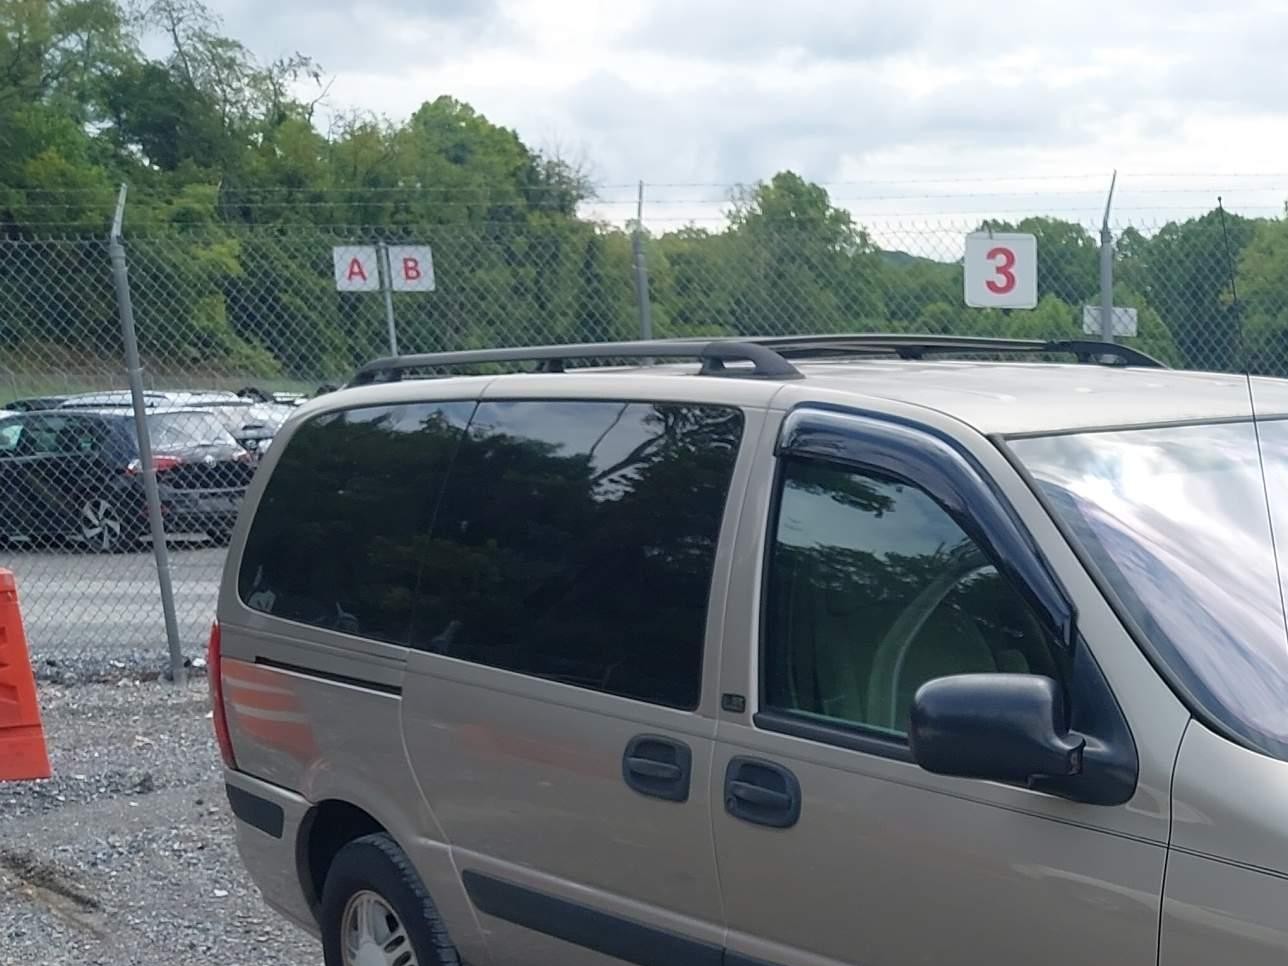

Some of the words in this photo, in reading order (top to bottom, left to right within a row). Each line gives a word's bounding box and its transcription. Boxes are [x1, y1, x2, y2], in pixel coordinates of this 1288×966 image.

[347, 257, 367, 281] A
[403, 257, 421, 281] B
[986, 247, 1016, 294] 3
